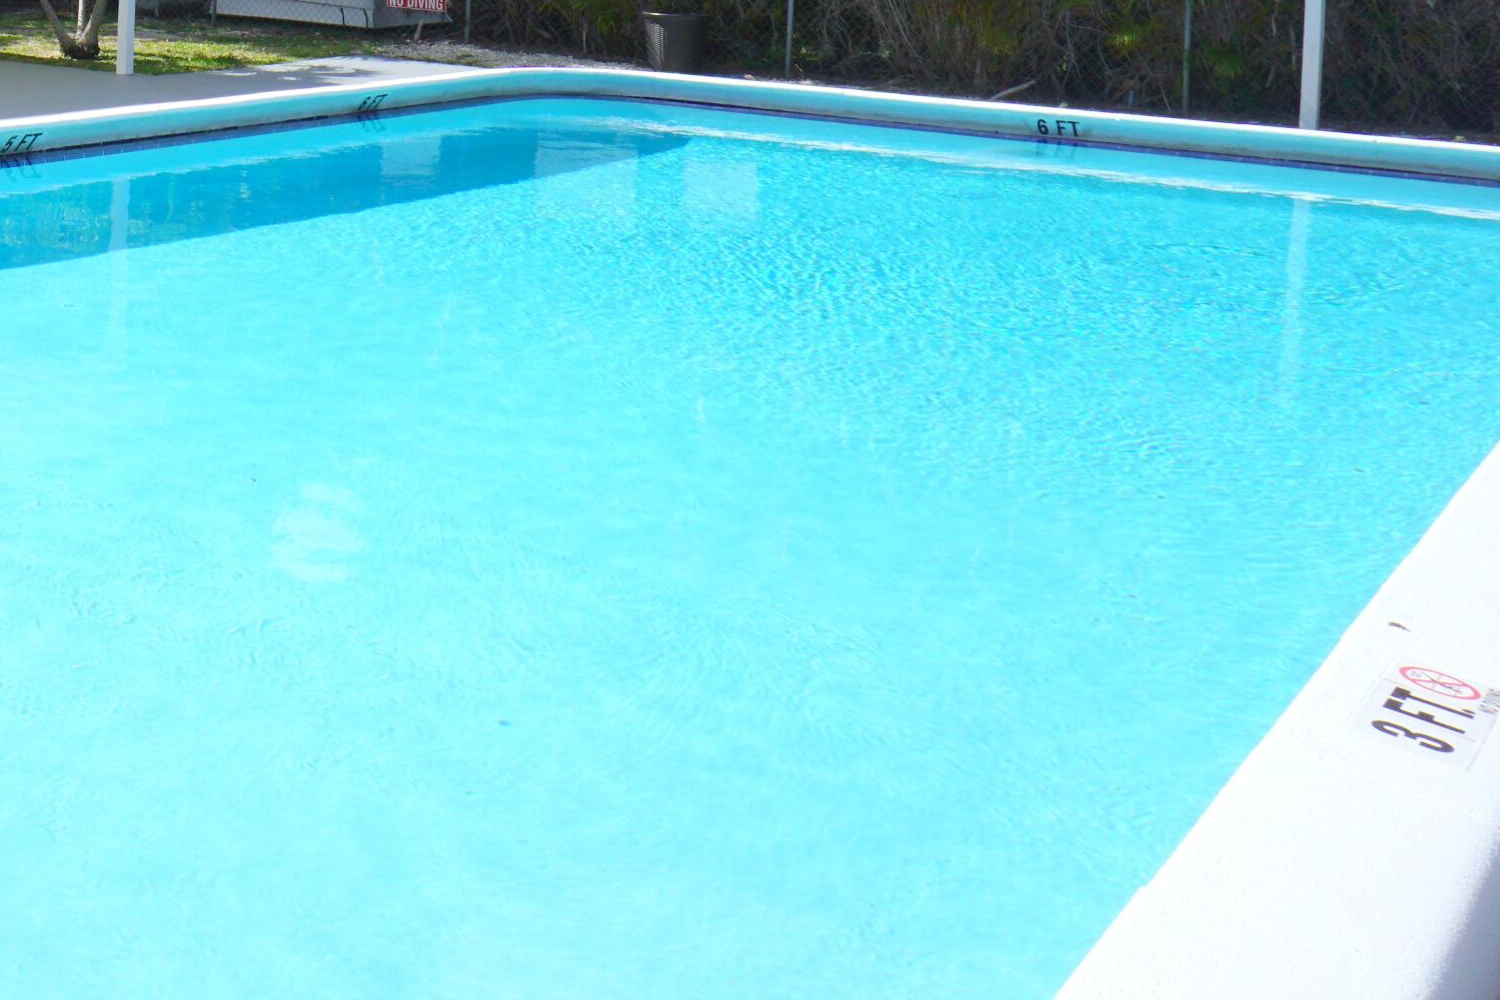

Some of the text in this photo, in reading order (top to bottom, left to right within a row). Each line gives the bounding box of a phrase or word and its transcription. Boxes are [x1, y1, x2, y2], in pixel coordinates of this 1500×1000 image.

[1037, 119, 1079, 137] 6 FT
[15, 132, 43, 151] FT
